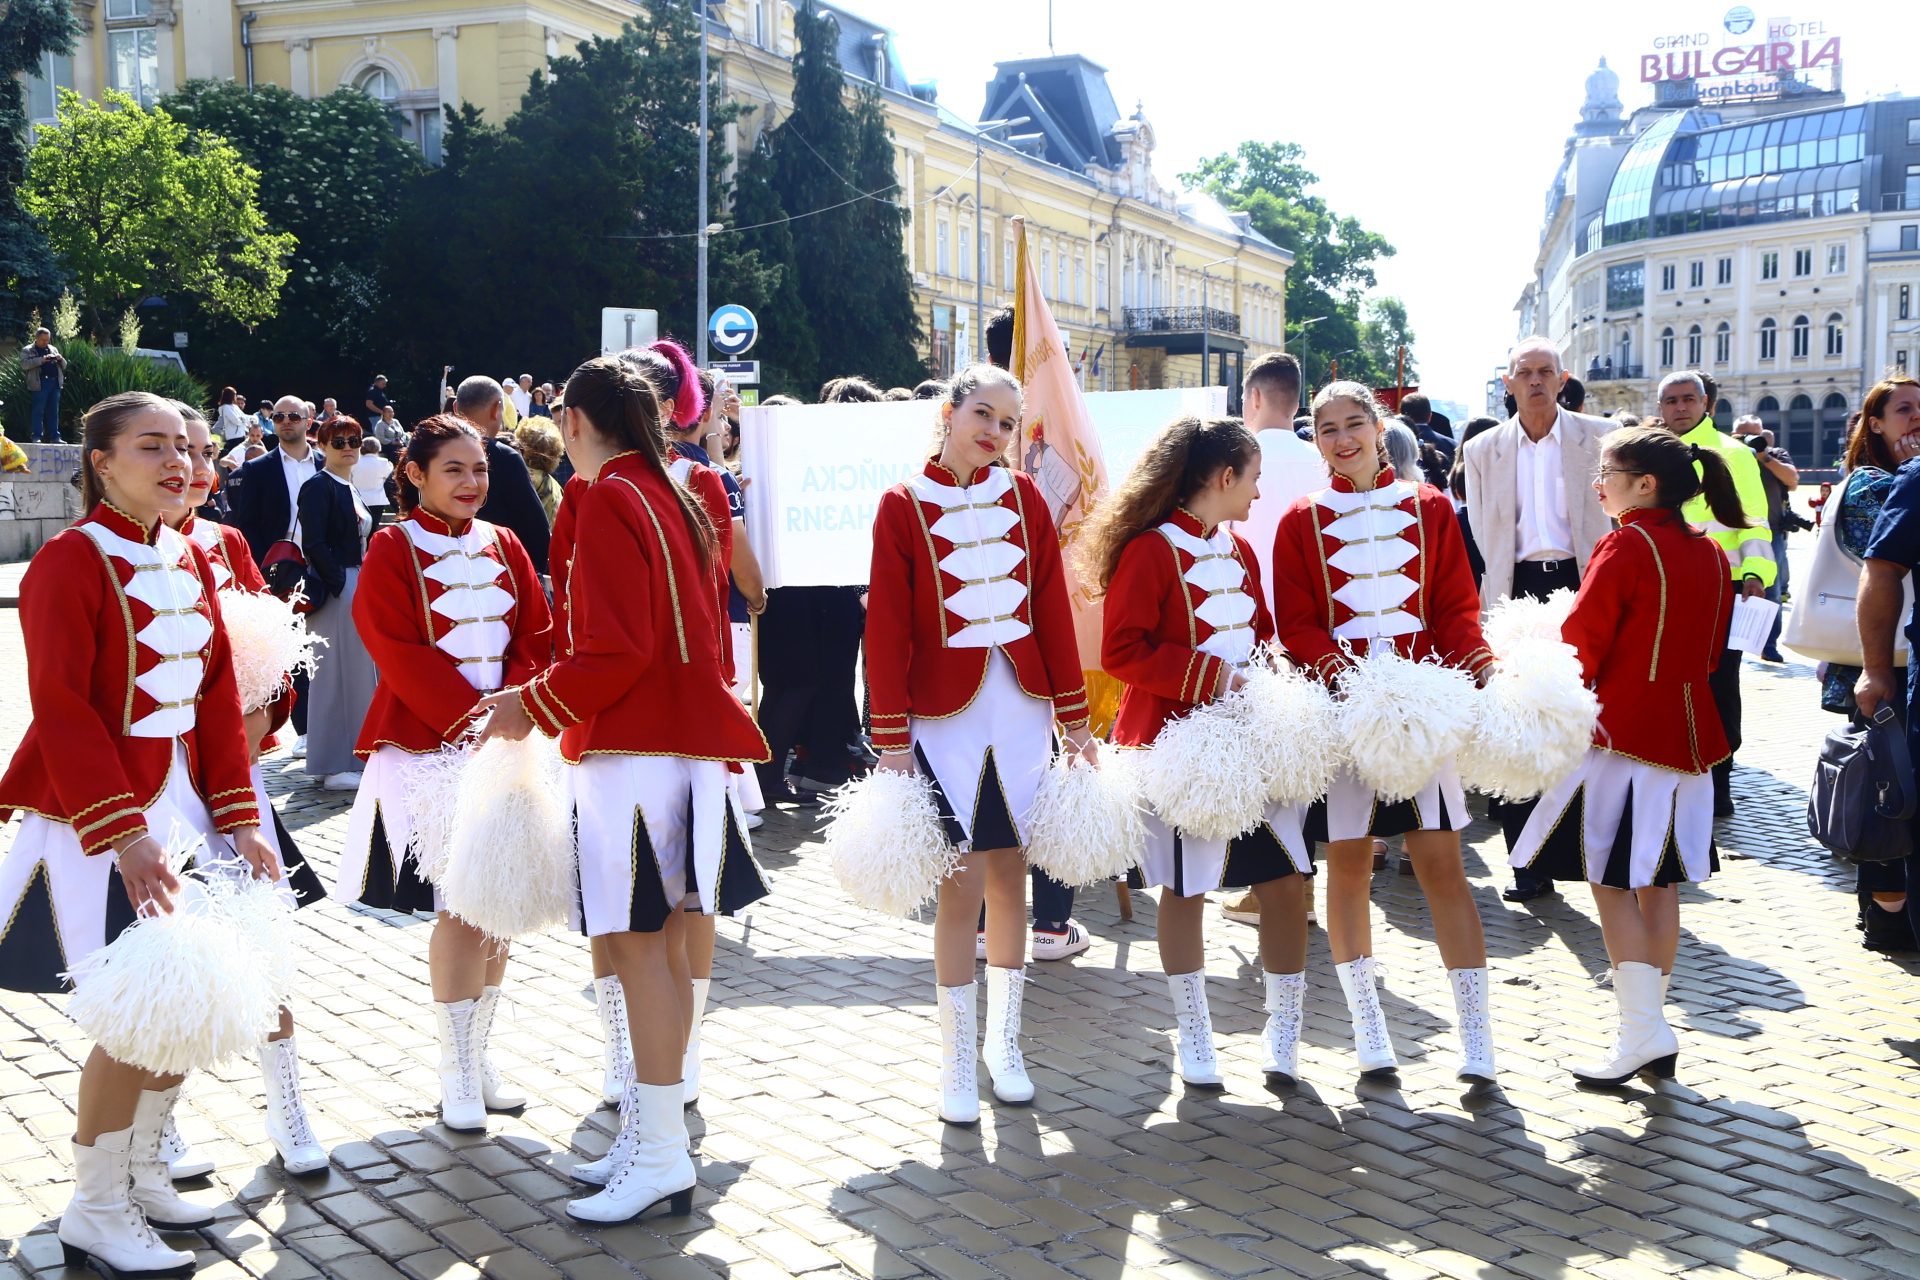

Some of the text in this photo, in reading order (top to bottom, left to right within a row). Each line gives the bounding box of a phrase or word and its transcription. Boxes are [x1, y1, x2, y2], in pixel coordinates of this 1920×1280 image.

[1653, 21, 1828, 49] GRAND HOTEL
[1640, 36, 1841, 83] BULGARIA
[1662, 73, 1814, 101] Balkantourist
[742, 395, 755, 403] N1
